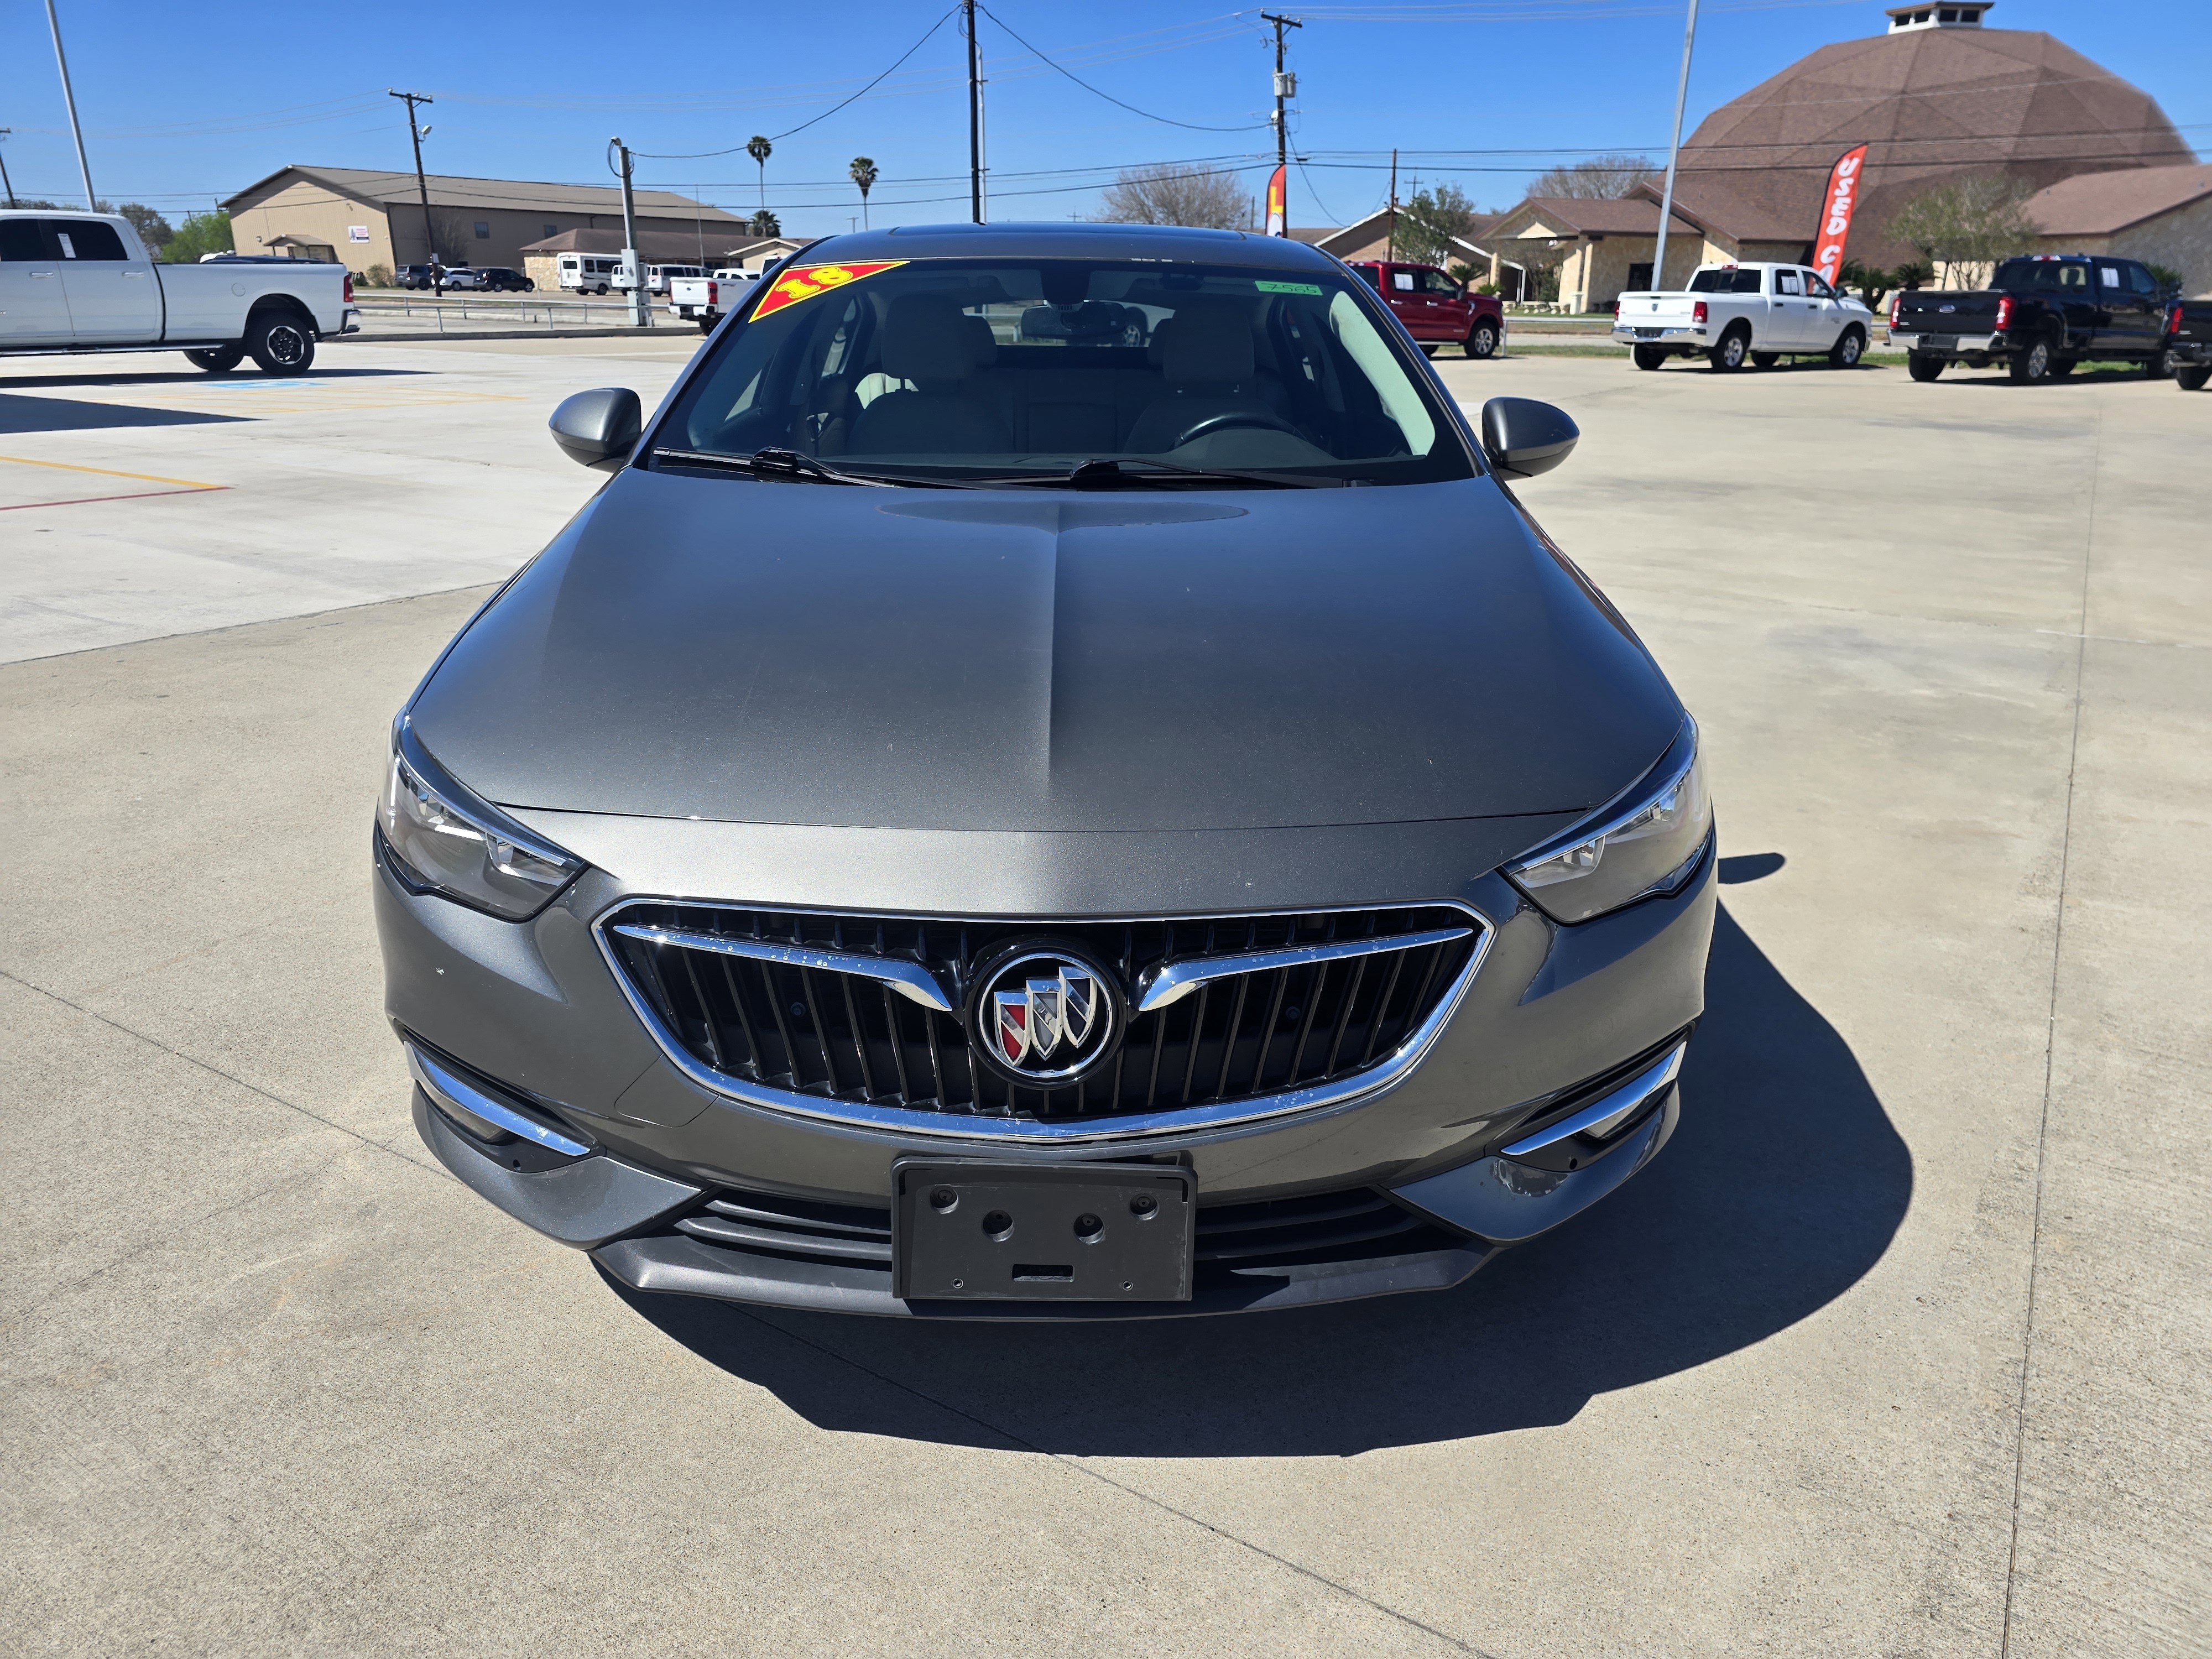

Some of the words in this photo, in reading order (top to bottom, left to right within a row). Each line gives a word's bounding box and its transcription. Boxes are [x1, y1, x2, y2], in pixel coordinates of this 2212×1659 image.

[1826, 156, 1860, 236] USED
[775, 267, 853, 299] 18
[1260, 282, 1317, 294] 7565
